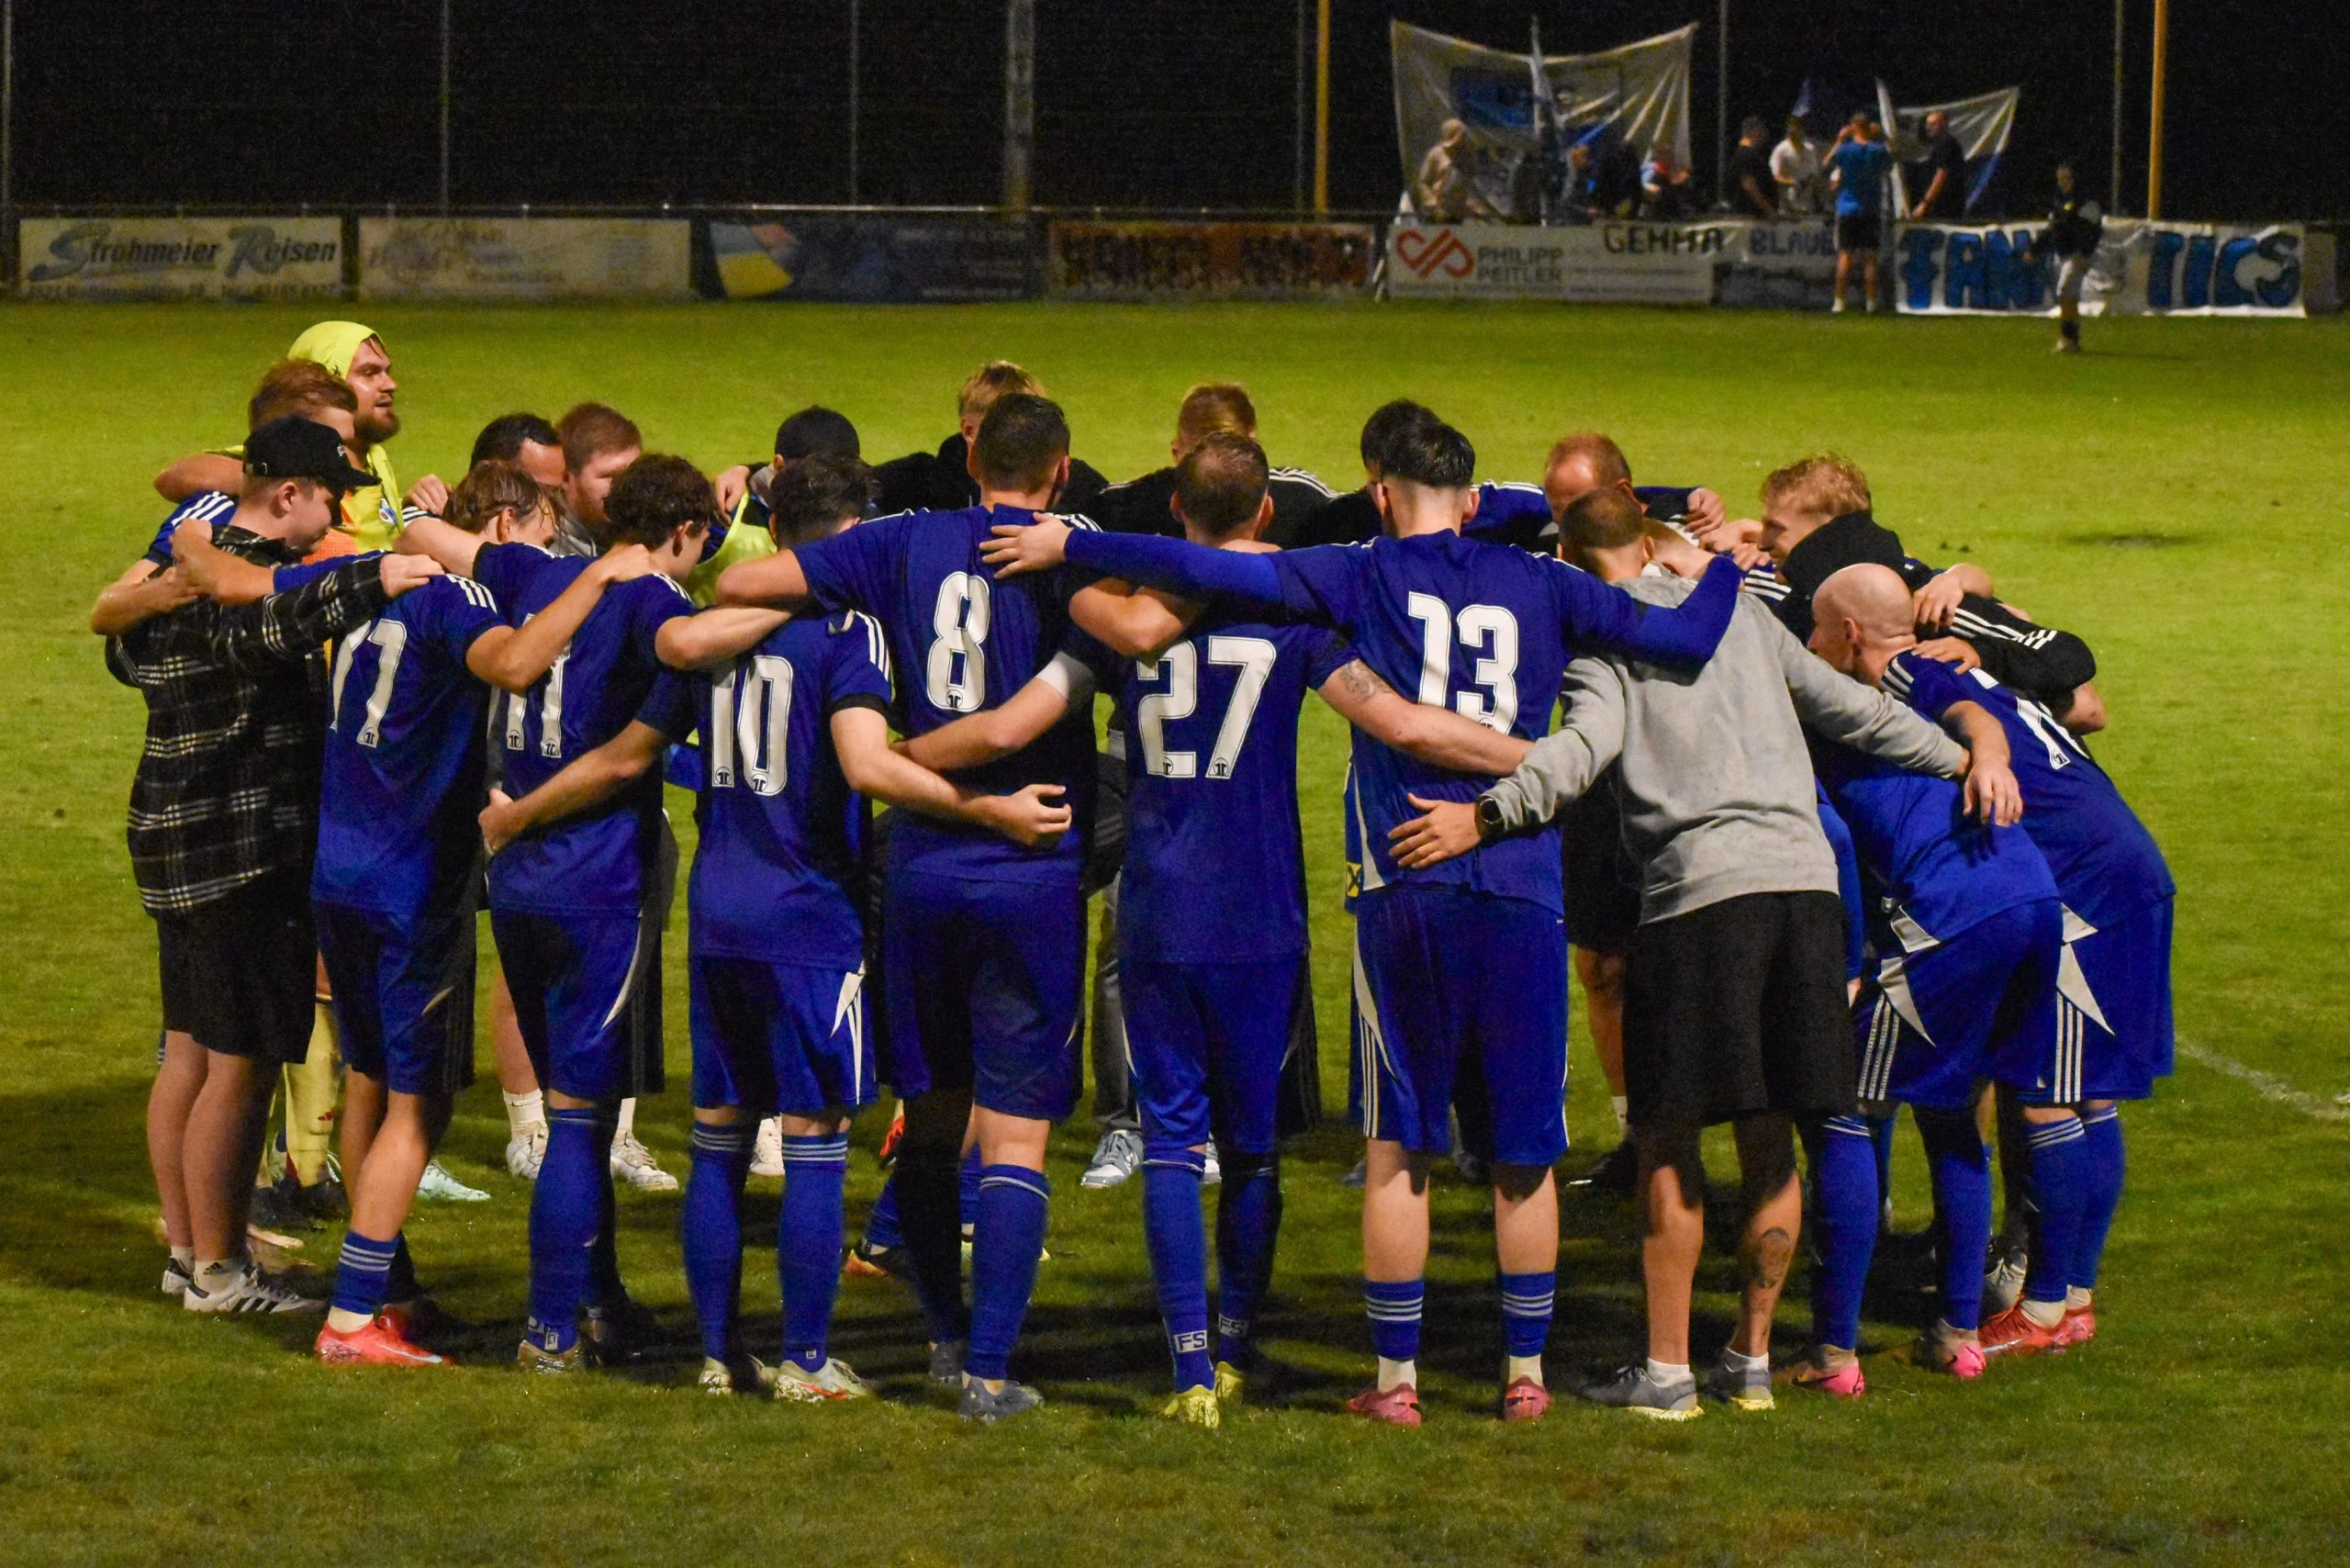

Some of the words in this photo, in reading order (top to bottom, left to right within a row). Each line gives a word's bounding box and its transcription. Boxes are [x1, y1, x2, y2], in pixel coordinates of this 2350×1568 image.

[1478, 245, 1564, 264] PHILIPP
[926, 571, 990, 712] 8
[1136, 635, 1277, 779] 27
[1408, 590, 1518, 735] 13
[711, 655, 794, 797] 10
[1177, 1331, 1206, 1351] FS
